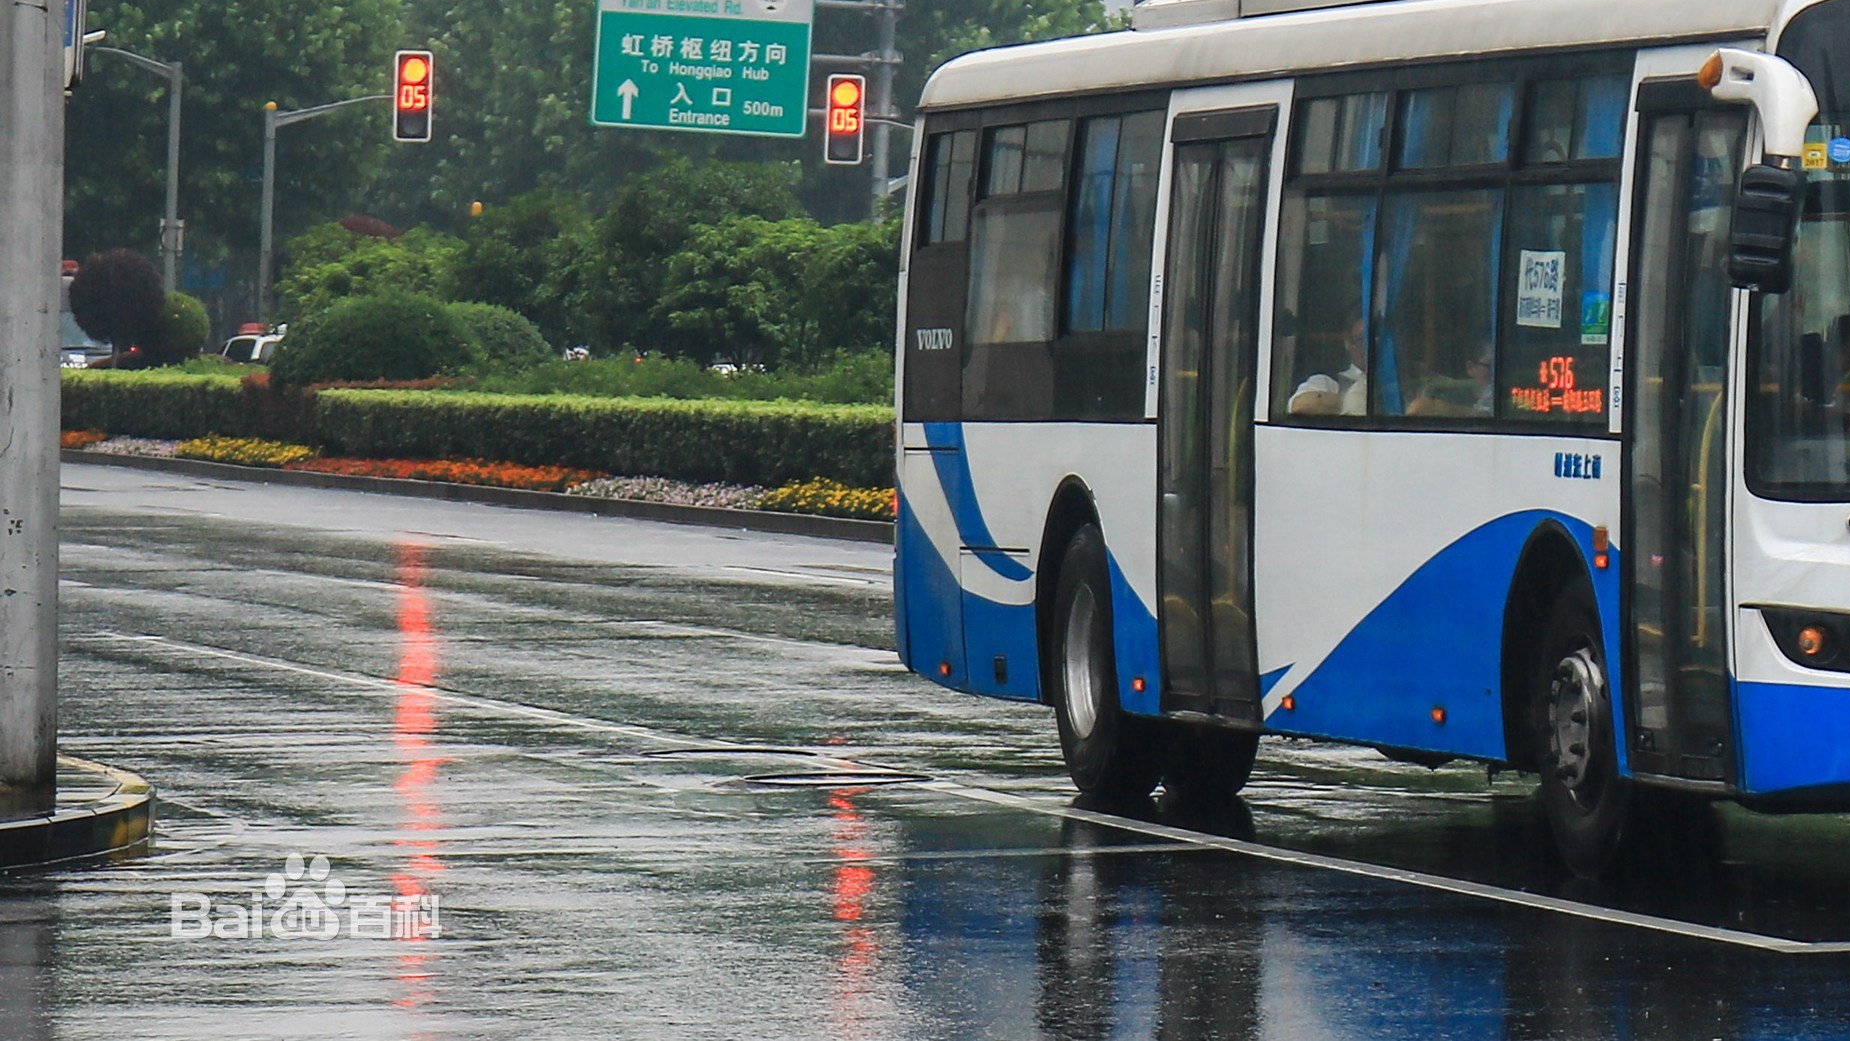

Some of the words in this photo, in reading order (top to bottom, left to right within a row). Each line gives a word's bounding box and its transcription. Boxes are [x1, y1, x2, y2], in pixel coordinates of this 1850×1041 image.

[621, 33, 787, 65] 虹桥枢纽方向
[641, 59, 659, 73] To
[669, 61, 732, 80] Hongqiao
[742, 66, 769, 80] Hub
[401, 86, 426, 109] 05
[669, 82, 732, 107] 入口
[669, 108, 730, 126] Entrance
[743, 100, 783, 117] 500m
[832, 109, 858, 131] 05
[916, 328, 953, 350] VOLVO
[1549, 356, 1574, 388] 576
